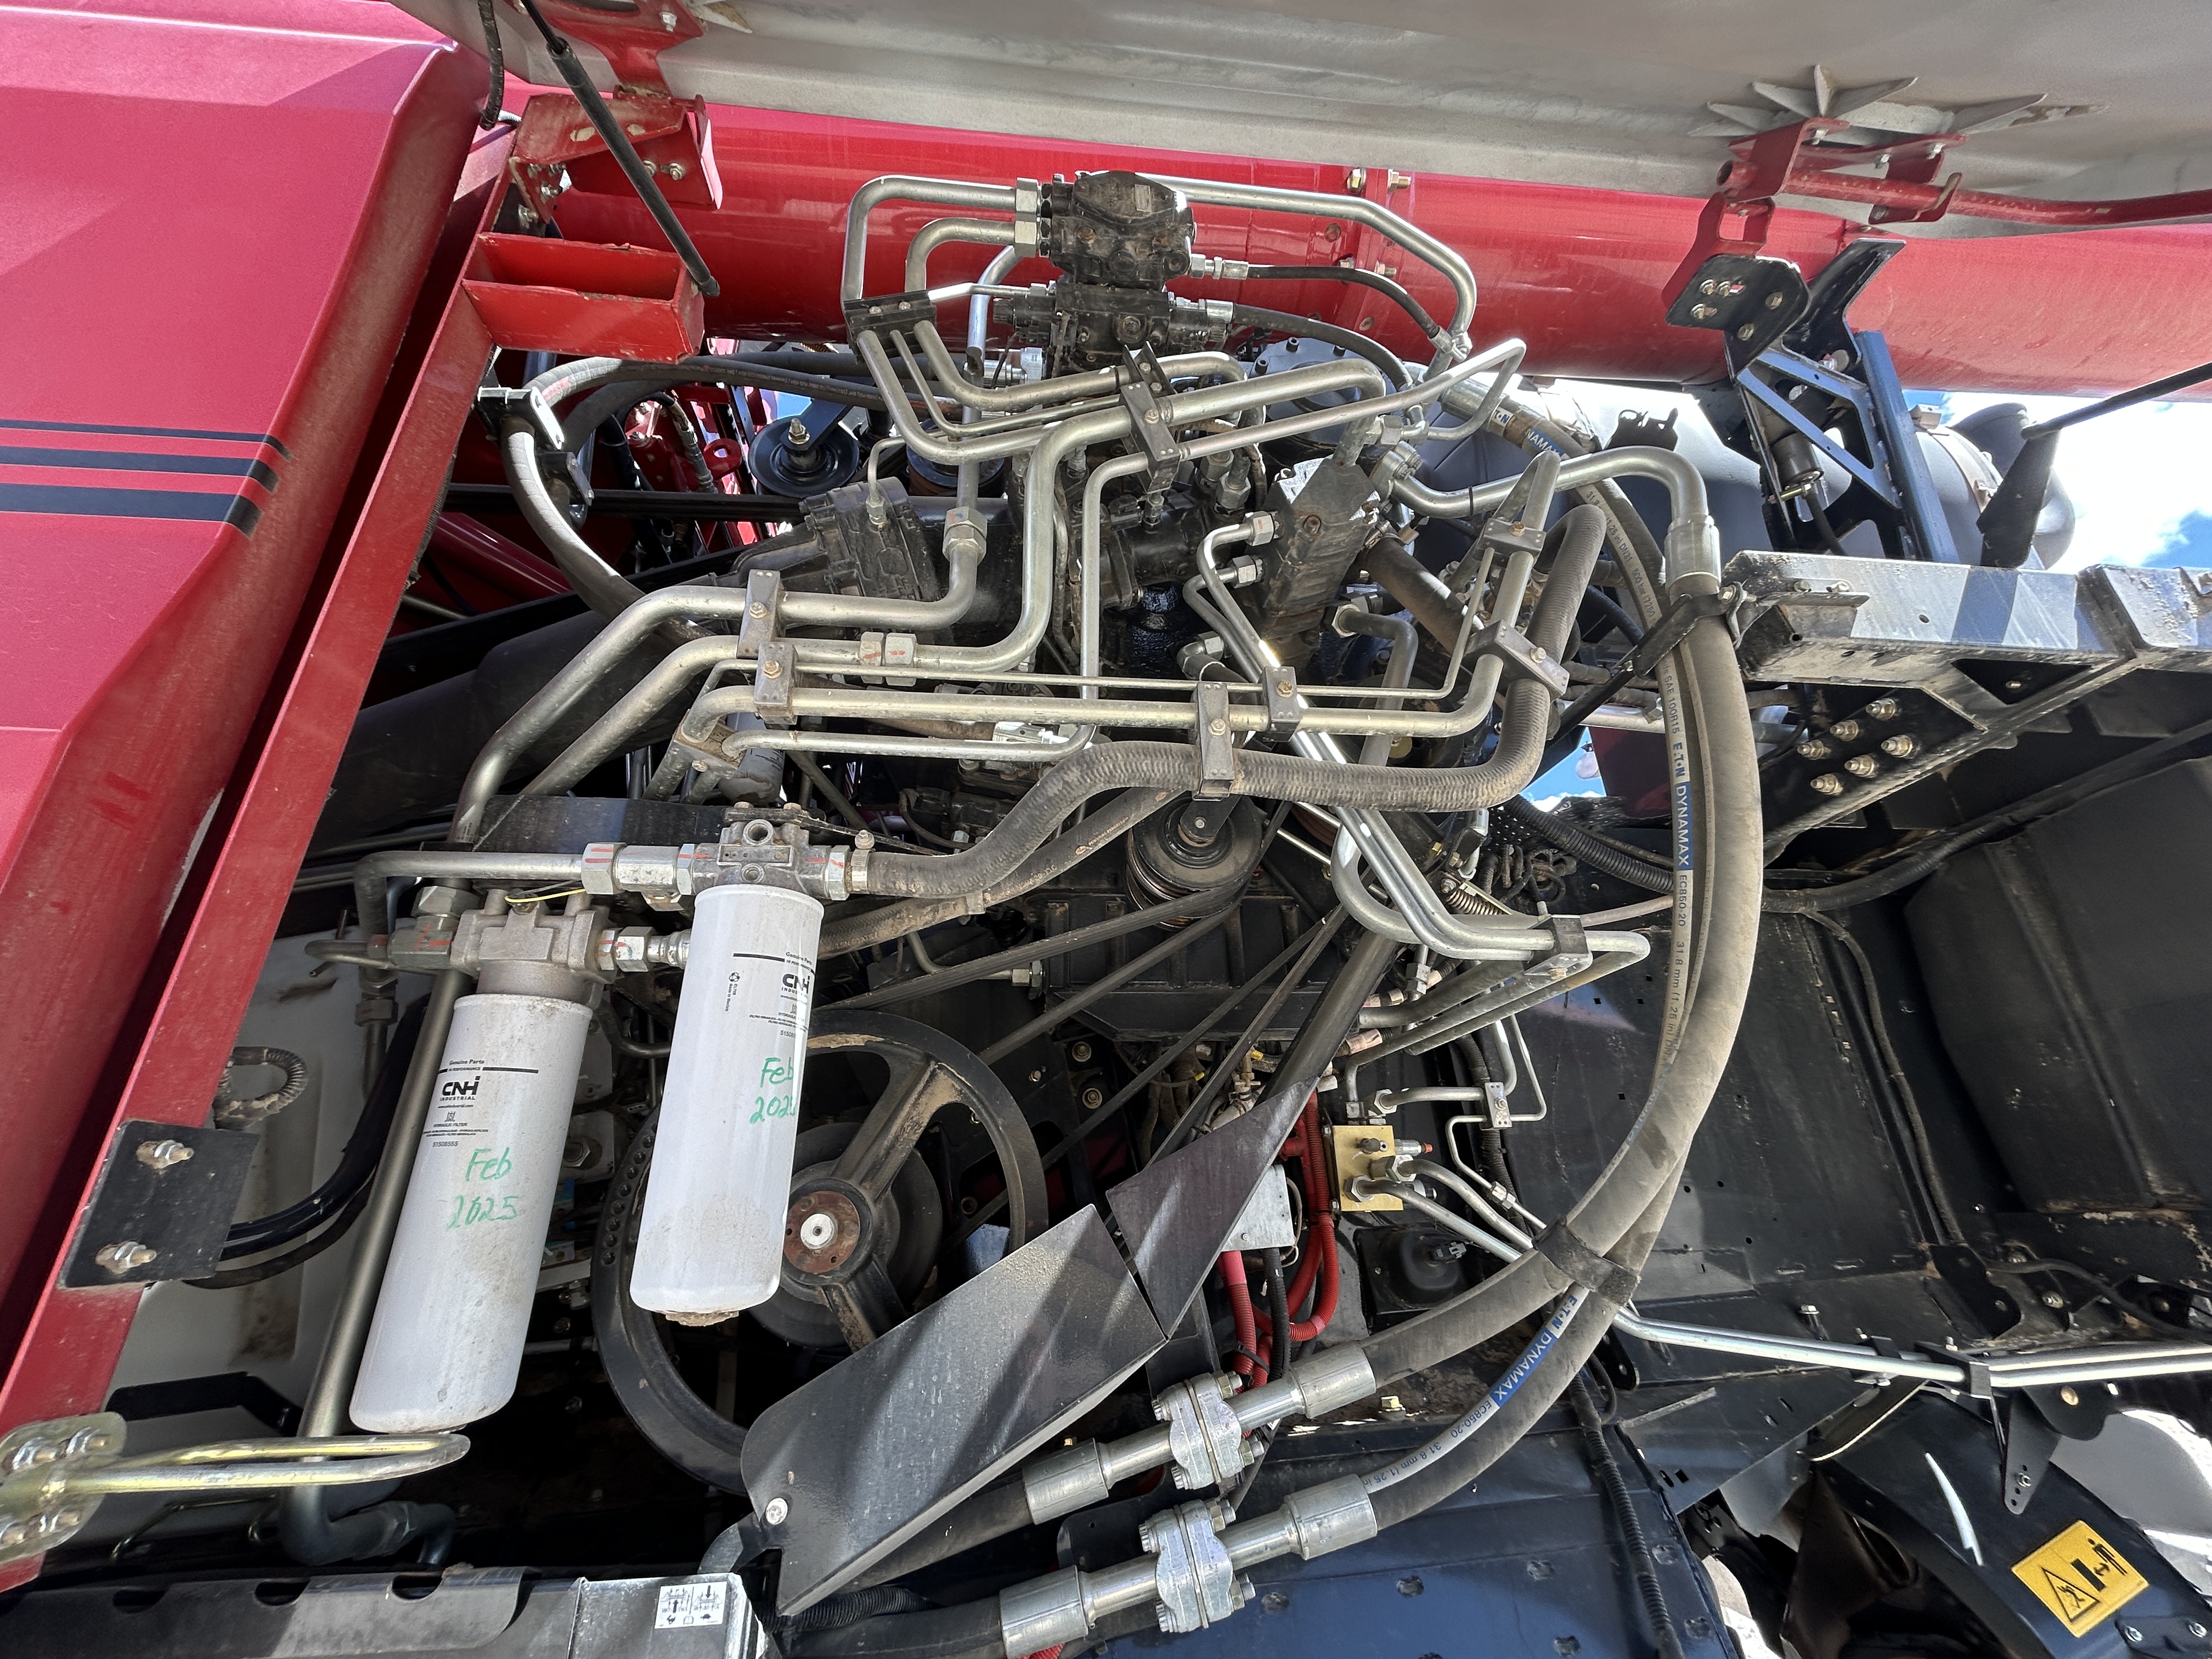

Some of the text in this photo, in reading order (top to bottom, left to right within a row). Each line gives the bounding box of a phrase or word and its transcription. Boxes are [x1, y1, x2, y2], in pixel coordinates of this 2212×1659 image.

[1525, 429, 1560, 455] NAMA
[1675, 785, 1689, 866] DYNAMAX
[1678, 874, 1688, 927] EC850-20
[1673, 969, 1681, 988] mm
[760, 1057, 794, 1088] Feb
[465, 1147, 512, 1181] Feb
[445, 1195, 518, 1231] 2025
[1494, 1331, 1553, 1400] DYNAMAX
[1451, 1400, 1492, 1438] EC850-20
[1402, 1455, 1418, 1469] mm
[1363, 1476, 1372, 1485] in
